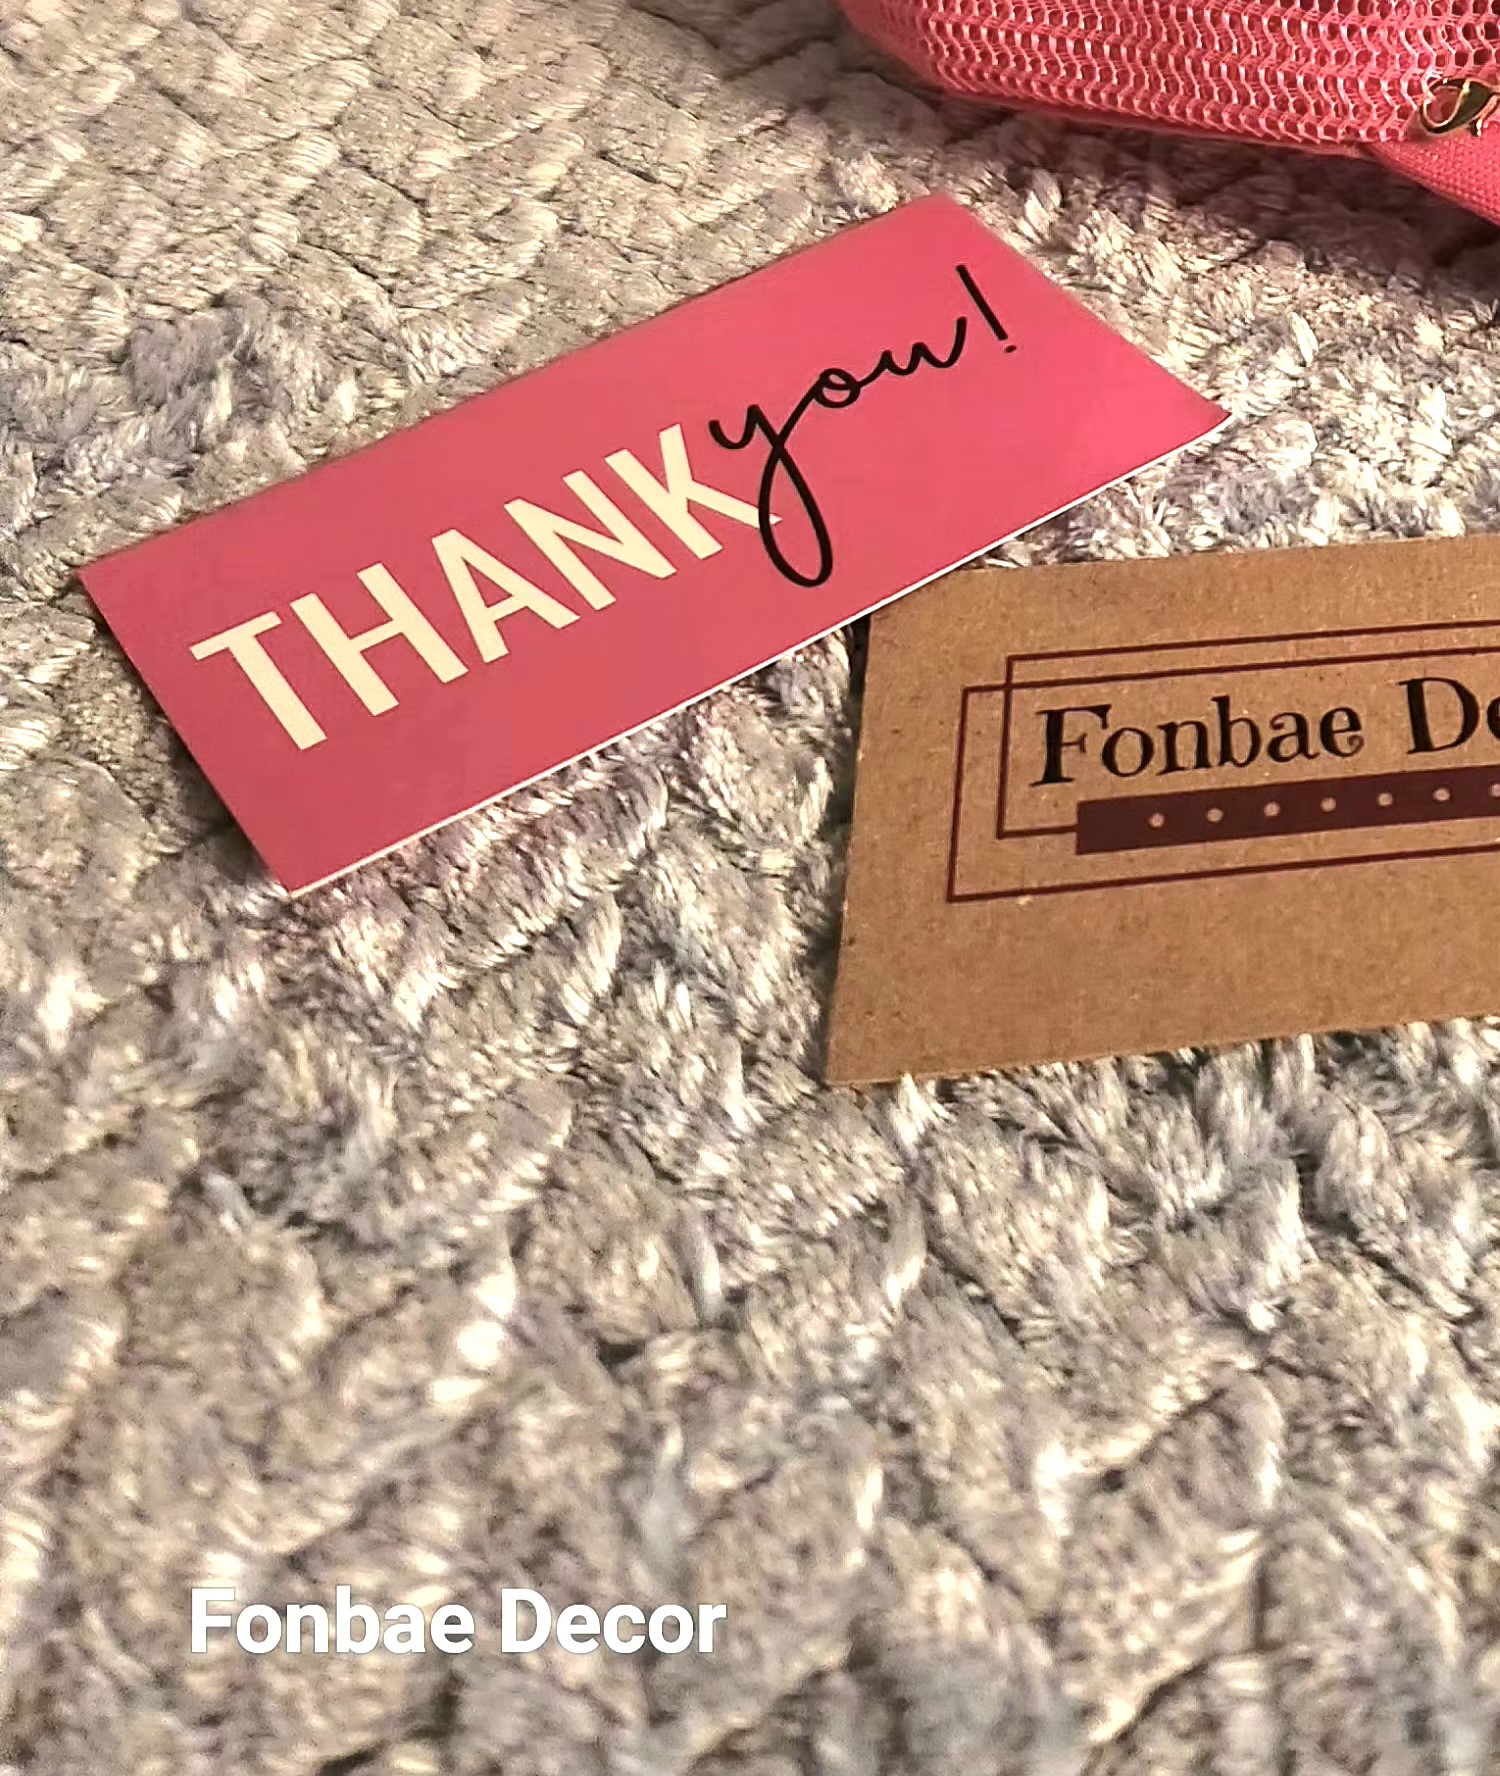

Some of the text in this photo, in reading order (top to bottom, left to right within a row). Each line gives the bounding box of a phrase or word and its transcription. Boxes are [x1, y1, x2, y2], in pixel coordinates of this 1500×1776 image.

[191, 264, 1016, 751] THANK you!
[1030, 694, 1365, 787] Fonbae
